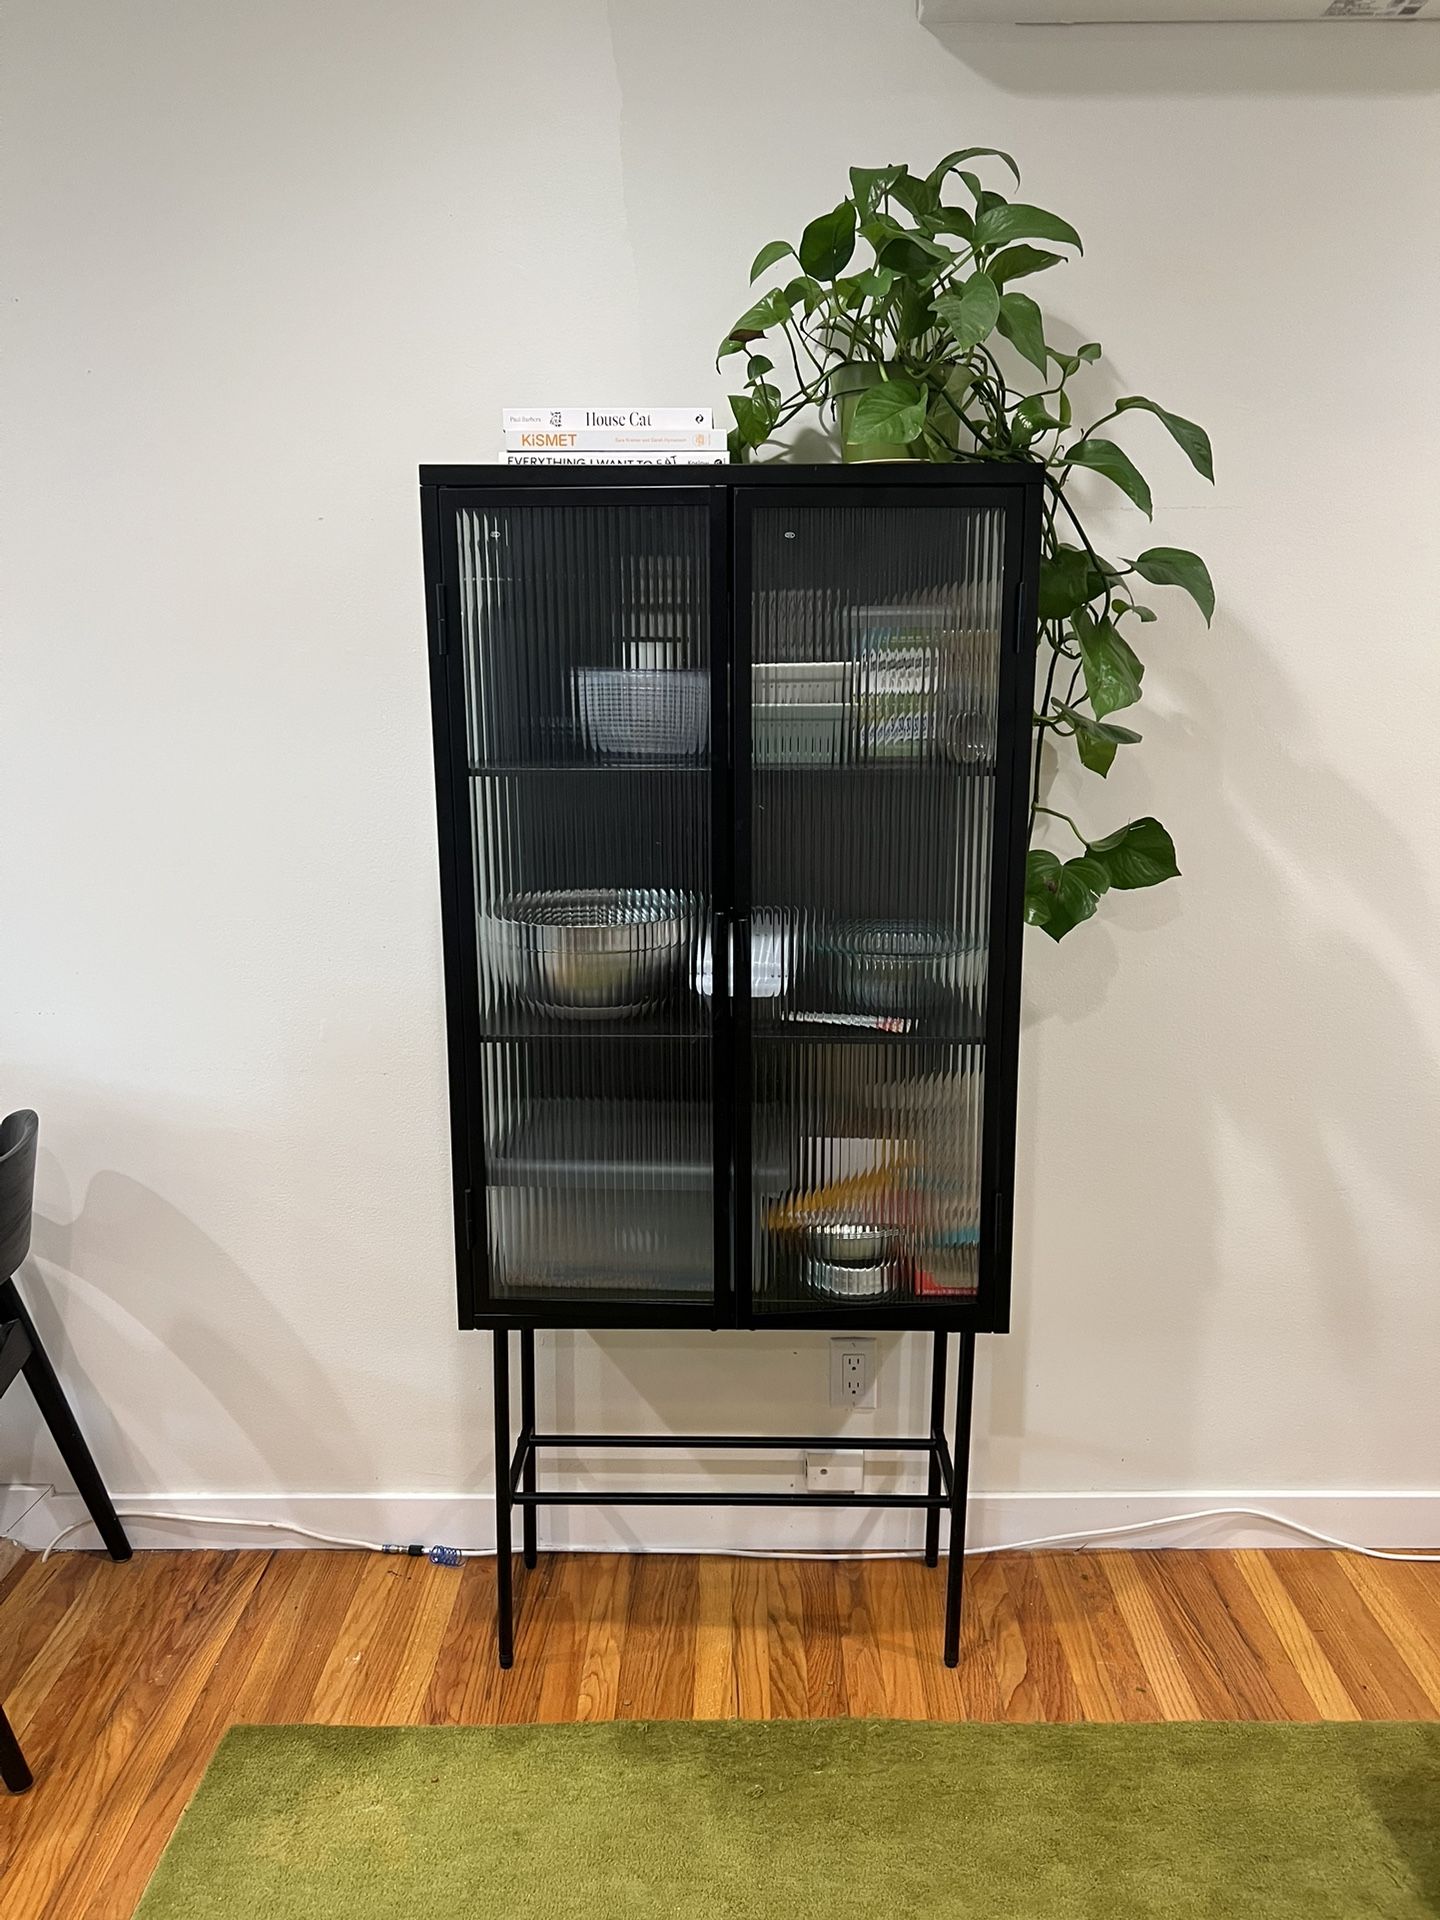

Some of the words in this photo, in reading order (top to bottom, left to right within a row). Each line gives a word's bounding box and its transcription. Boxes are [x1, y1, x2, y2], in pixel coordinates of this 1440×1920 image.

[586, 412, 626, 426] House
[629, 411, 652, 426] Cat
[521, 433, 577, 446] KiSMET
